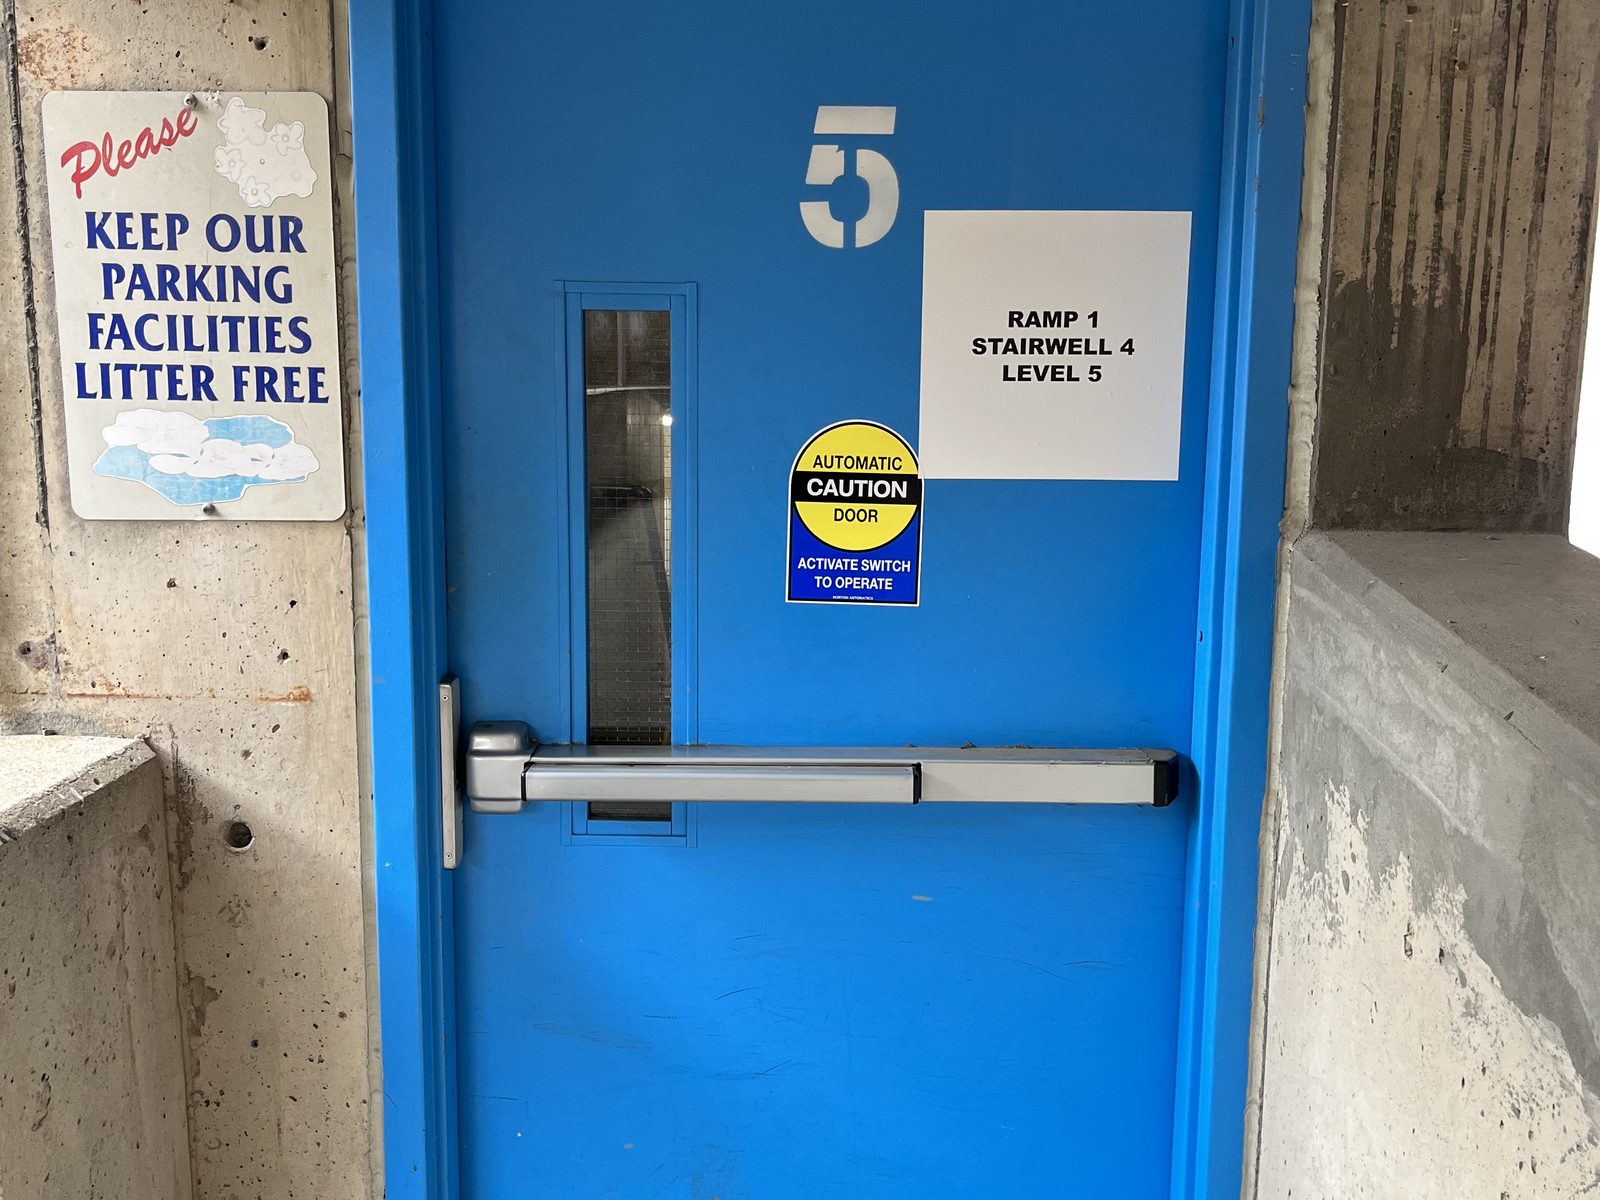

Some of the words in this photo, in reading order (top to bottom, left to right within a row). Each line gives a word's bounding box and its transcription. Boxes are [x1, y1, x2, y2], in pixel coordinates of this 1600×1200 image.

[61, 107, 198, 199] Please
[800, 106, 899, 248] 5
[85, 211, 189, 250] KEEP
[205, 213, 307, 253] OUR
[101, 262, 292, 304] PARKING
[1008, 311, 1078, 328] RAMP
[1087, 311, 1099, 328] 1
[87, 313, 312, 354] FACILITIES
[971, 338, 1112, 355] STAIRWELL
[1120, 338, 1135, 356] 4
[75, 362, 218, 401] LITTER
[233, 366, 329, 404] FREE
[1002, 365, 1079, 382] LEVEL
[1088, 365, 1102, 382] 5
[813, 455, 903, 471] AUTOMATIC
[806, 478, 908, 499] CAUTION
[833, 508, 878, 523] DOOR
[797, 557, 858, 571] ACTIVATE
[860, 559, 911, 572] SWITCH
[814, 576, 832, 588] TO
[835, 577, 893, 590] OPERATE
